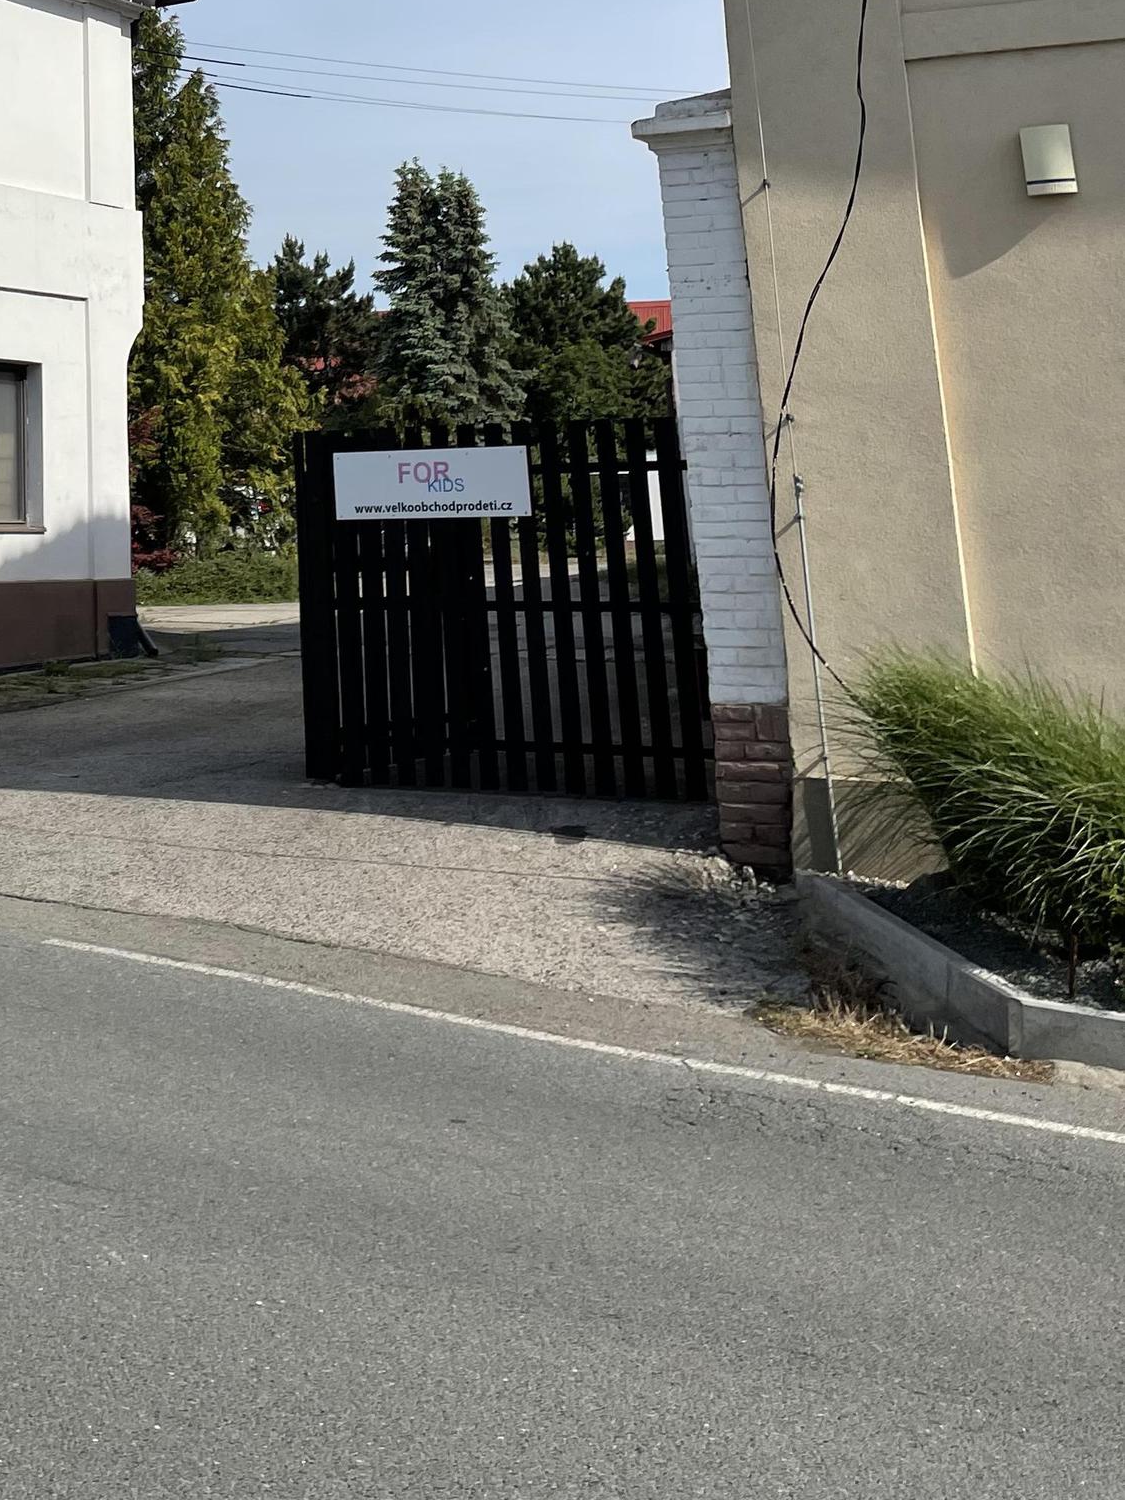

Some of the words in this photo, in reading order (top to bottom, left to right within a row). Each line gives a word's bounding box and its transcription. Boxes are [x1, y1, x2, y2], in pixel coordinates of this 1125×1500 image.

[398, 461, 450, 484] FOR
[427, 478, 465, 493] KIDS
[354, 500, 513, 514] www.velkoobchodprodeti.cz
